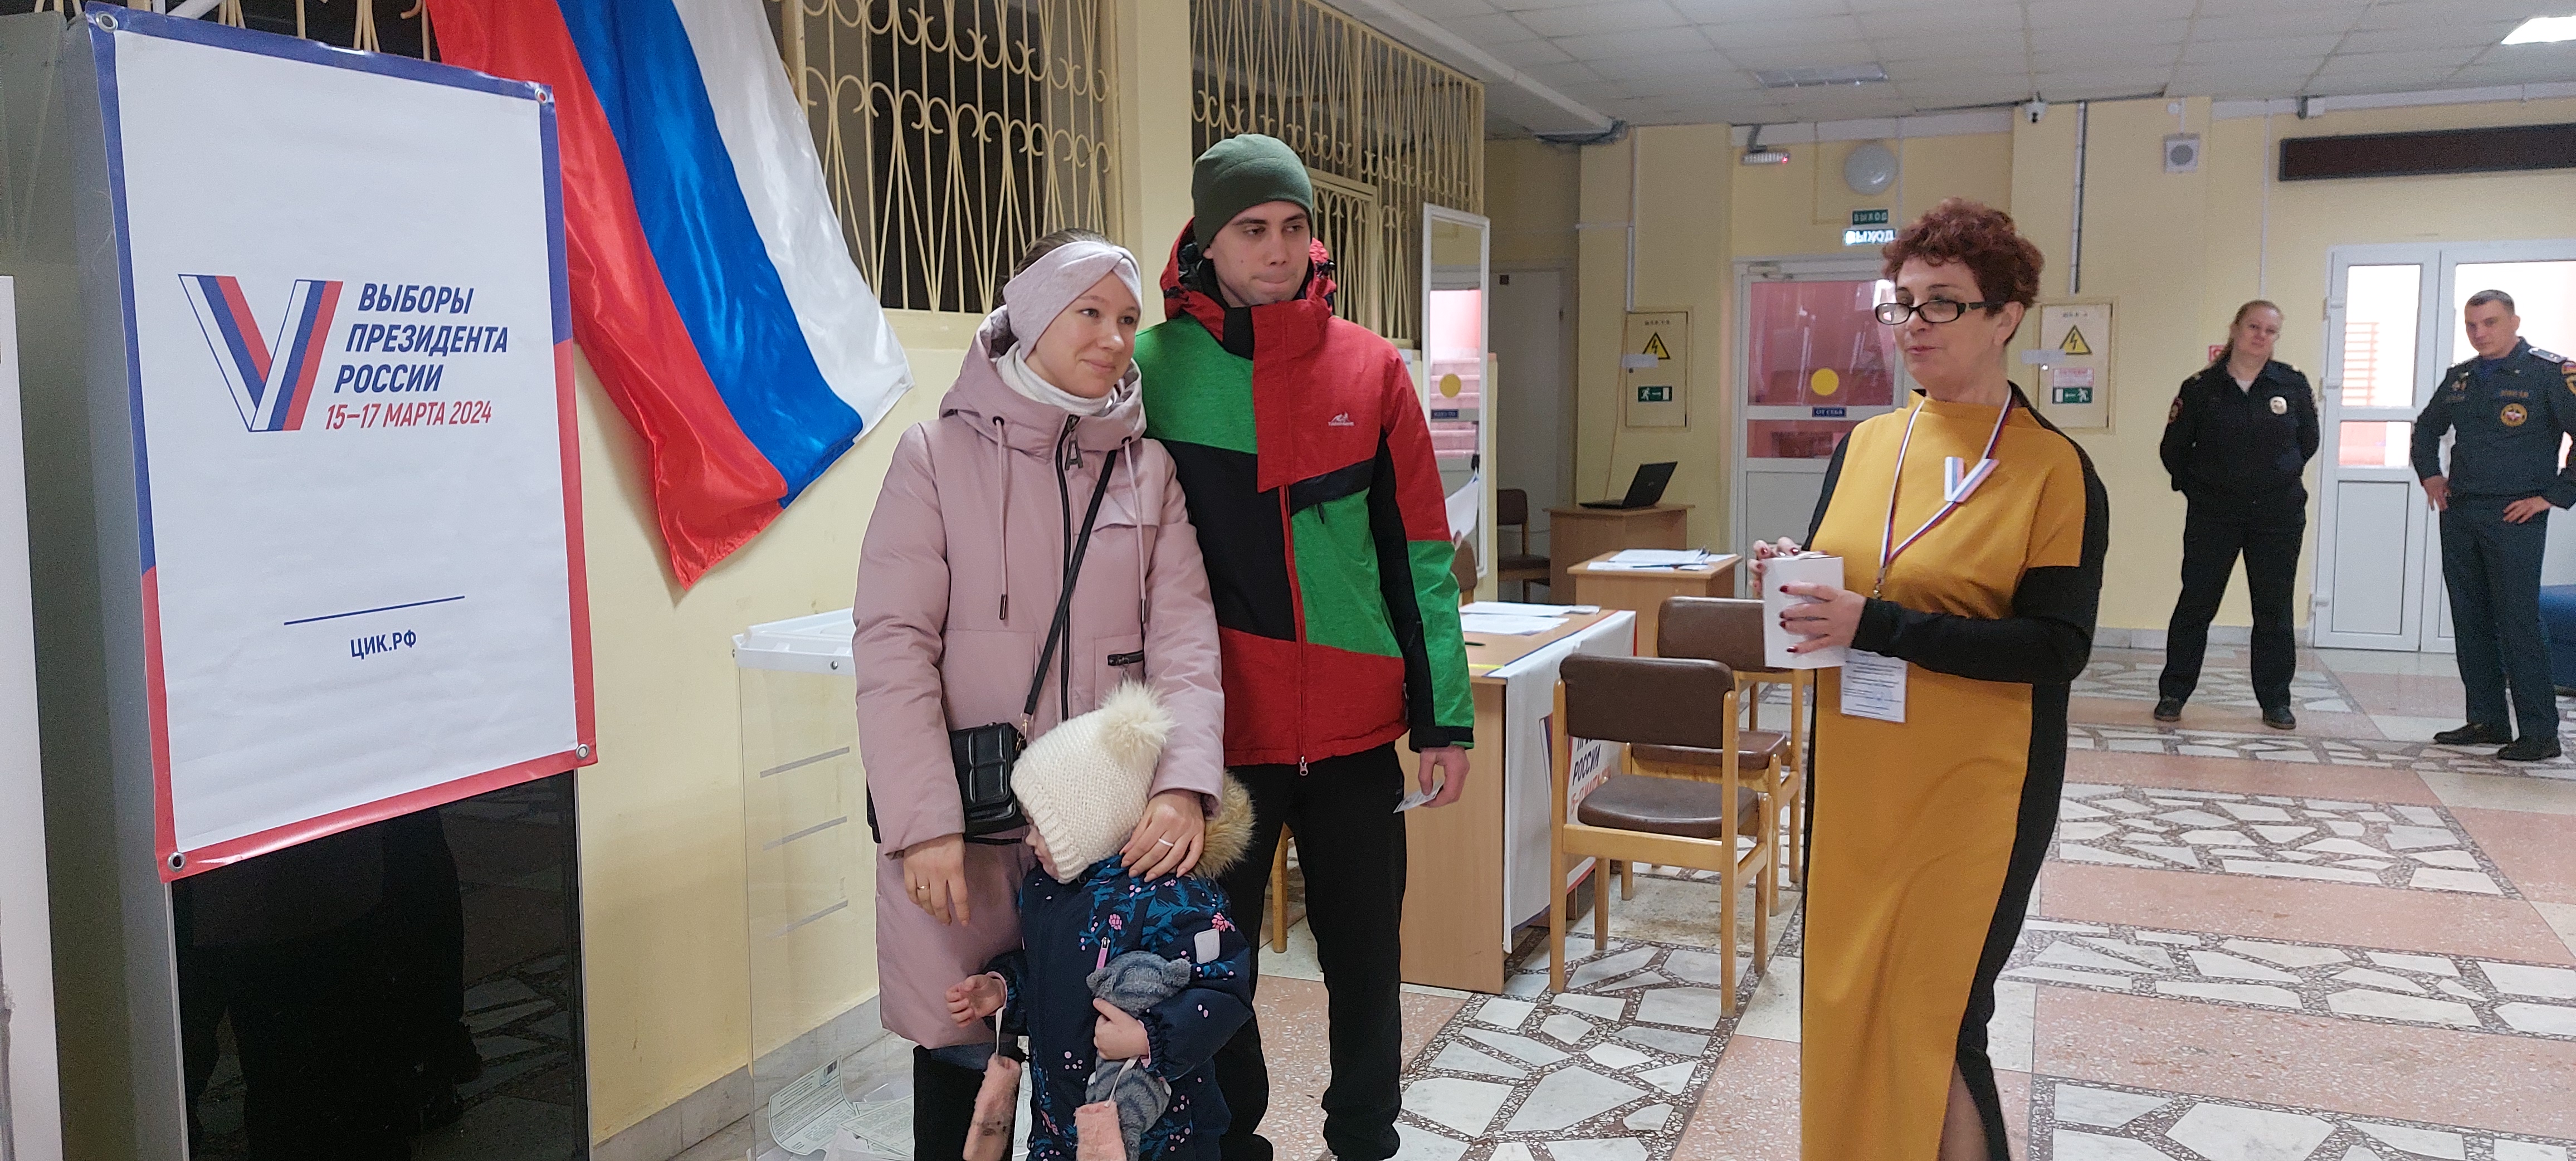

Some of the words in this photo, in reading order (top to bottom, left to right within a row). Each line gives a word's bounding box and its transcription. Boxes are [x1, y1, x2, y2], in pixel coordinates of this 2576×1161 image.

[358, 282, 474, 314] ВЫБОРЫ
[345, 323, 508, 357] ПРЕЗИДЕНТА
[334, 364, 444, 393] РОССИИ
[382, 401, 446, 427] МАРТА
[448, 400, 492, 425] 2024
[350, 629, 417, 660] ЦИК.РФ
[1572, 743, 1602, 786] РОССИИ
